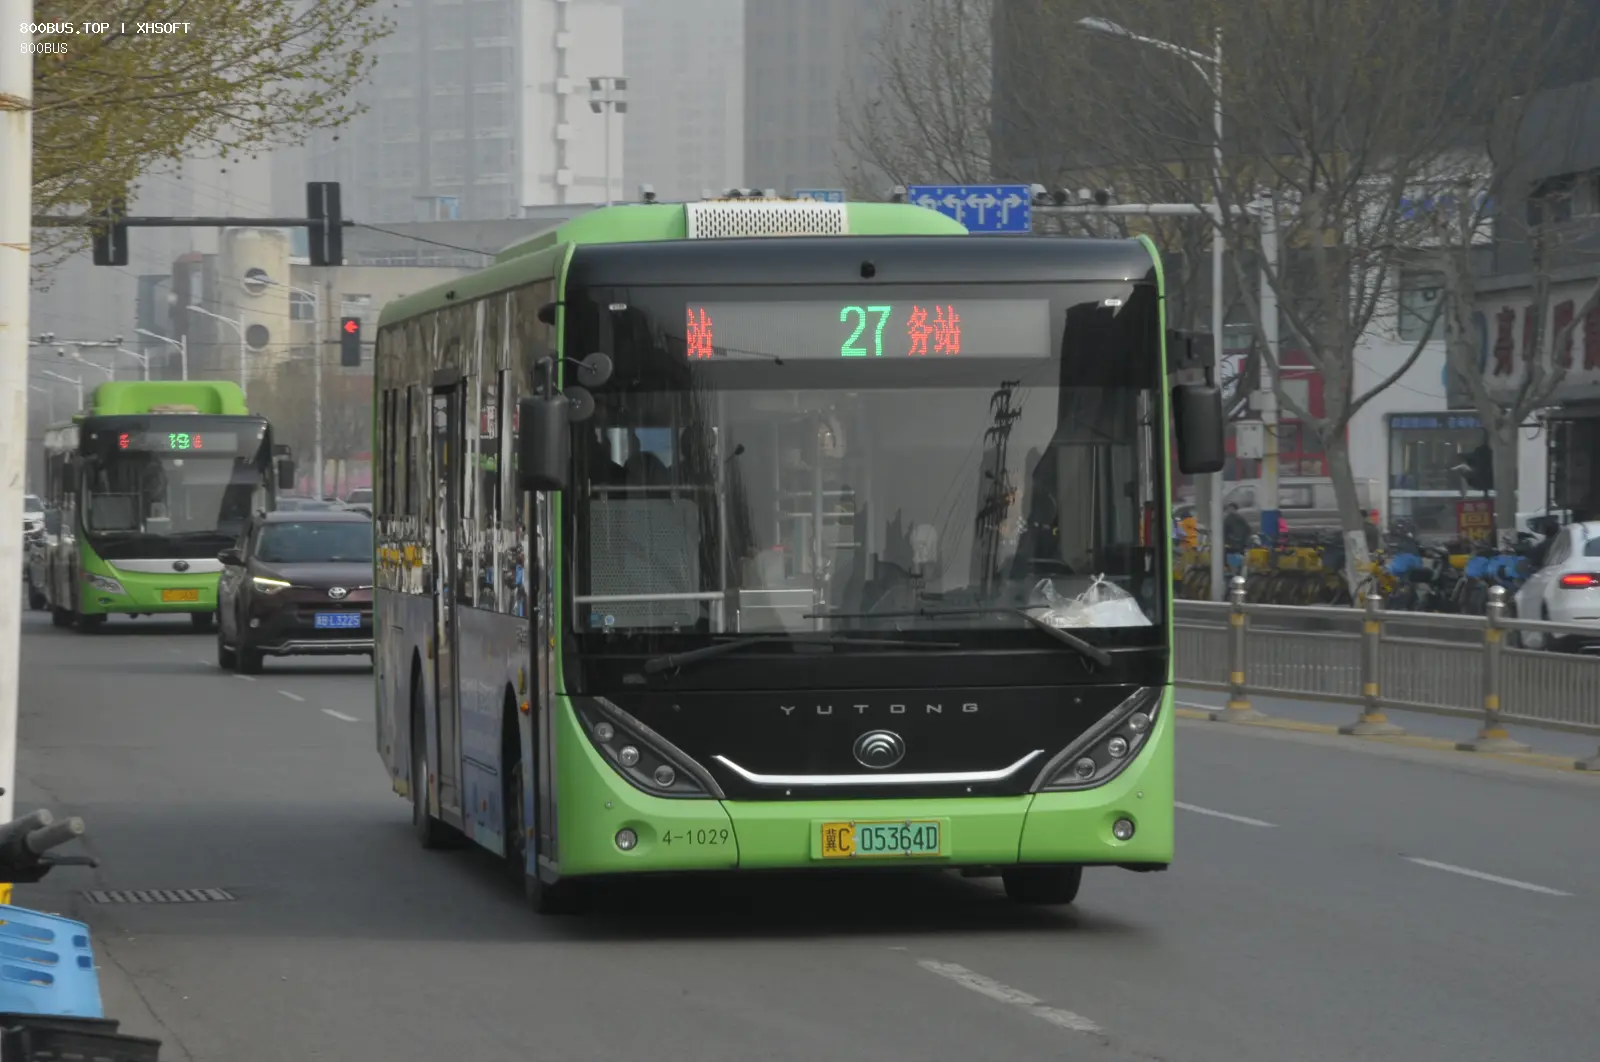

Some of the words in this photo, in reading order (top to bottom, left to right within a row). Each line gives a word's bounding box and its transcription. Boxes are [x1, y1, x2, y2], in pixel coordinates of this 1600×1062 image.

[687, 307, 713, 359] 站
[839, 306, 891, 356] 27
[906, 304, 962, 356] 务站
[780, 703, 979, 716] YUTONG
[662, 829, 730, 846] 4-1029
